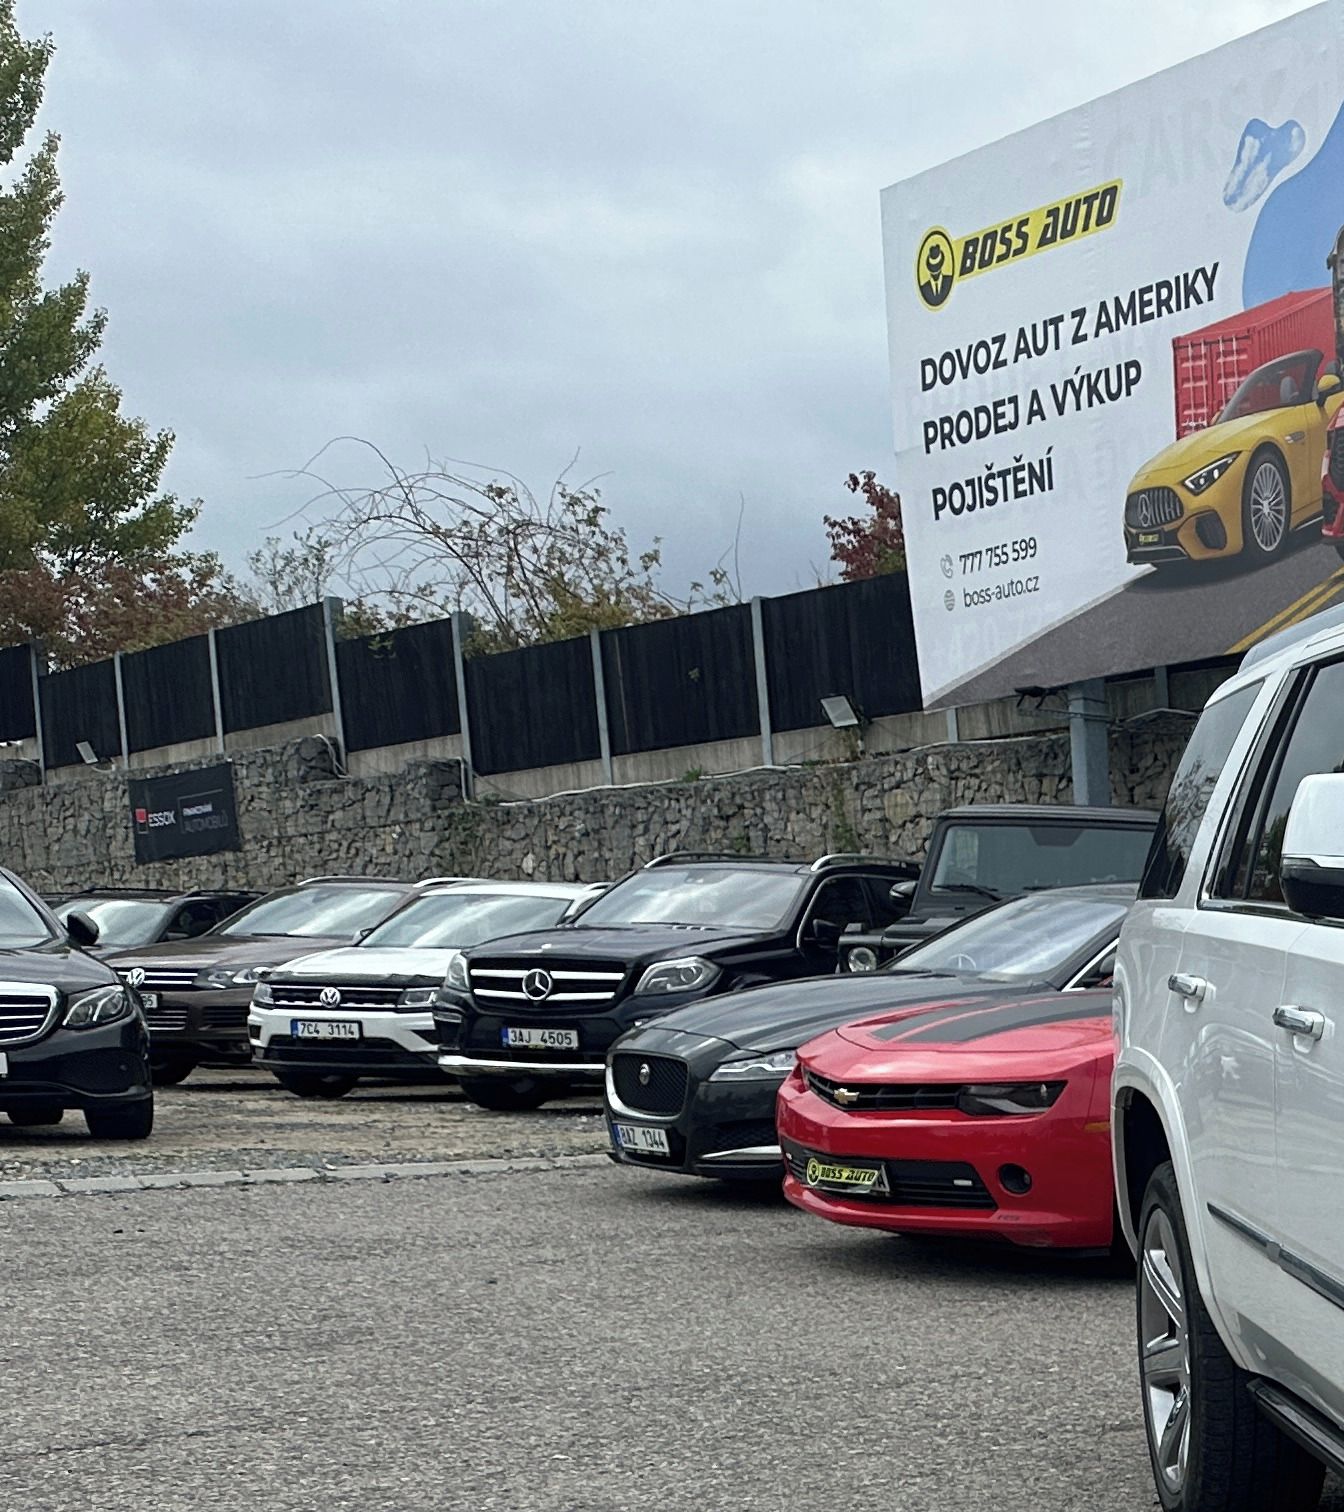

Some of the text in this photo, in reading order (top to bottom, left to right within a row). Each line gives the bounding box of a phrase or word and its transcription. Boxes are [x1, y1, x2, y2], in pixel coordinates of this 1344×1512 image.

[958, 185, 1119, 277] BOSS AUTO
[920, 261, 1220, 392] DOVOZ AUT Z AMERIKY
[923, 359, 1142, 454] PRODEJ A VÝKUP
[931, 446, 1054, 521] POJIŠTĚNÍ
[959, 536, 1037, 575] 777 755 599
[963, 575, 1040, 608] boss-auto.cz
[148, 811, 176, 827] ESSOX
[300, 1022, 320, 1035] 7C4
[327, 1023, 354, 1036] 3114
[510, 1030, 531, 1043] 3AJ
[540, 1031, 572, 1045] 4505
[821, 1166, 876, 1182] BOSS AUTO
